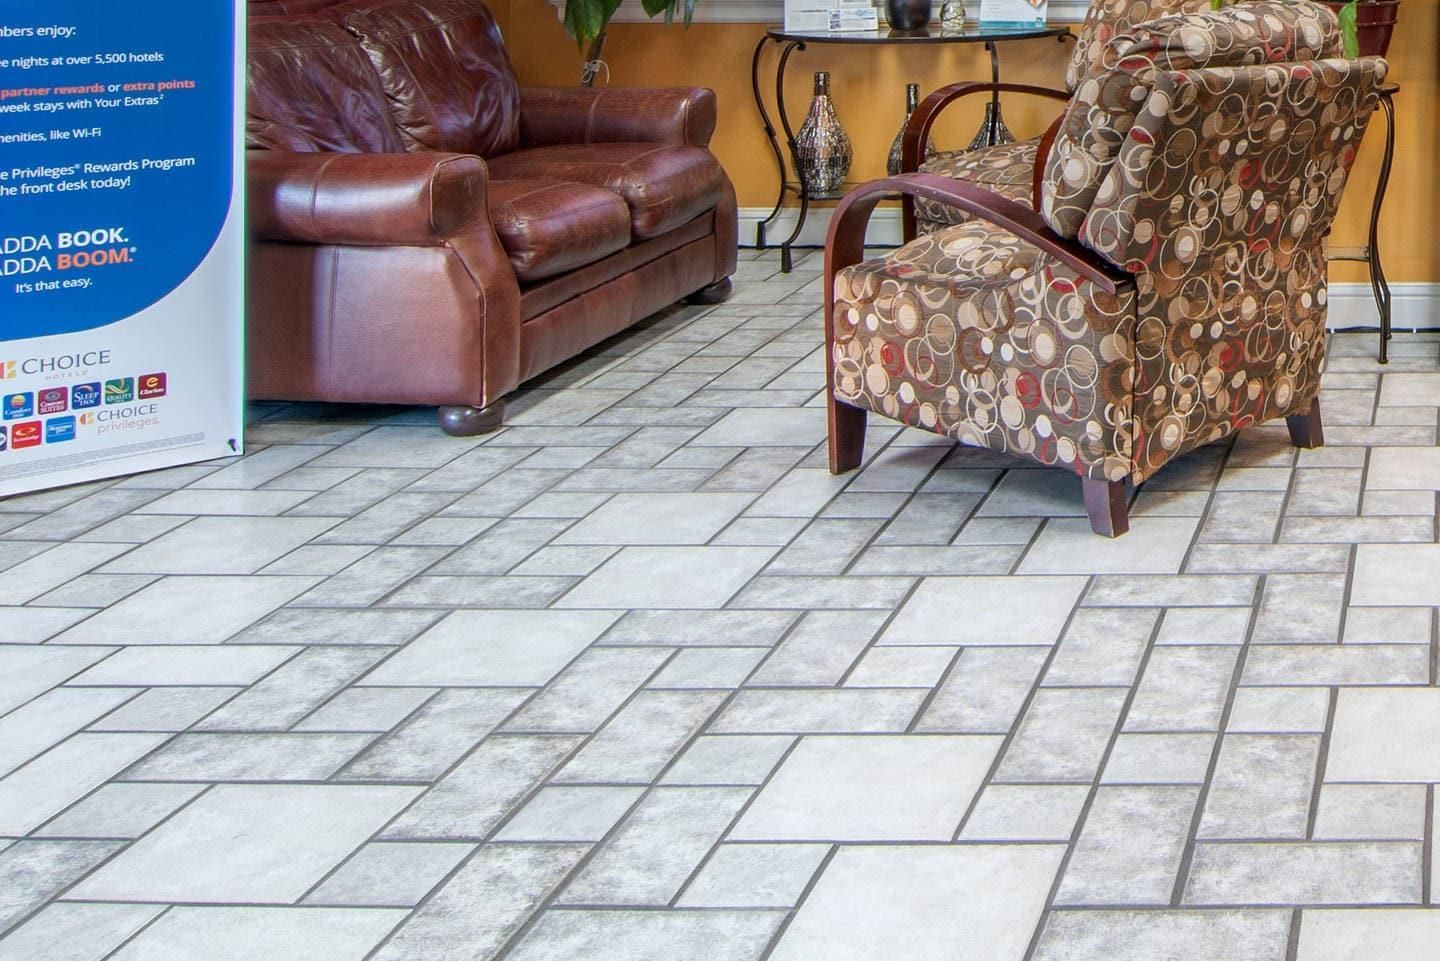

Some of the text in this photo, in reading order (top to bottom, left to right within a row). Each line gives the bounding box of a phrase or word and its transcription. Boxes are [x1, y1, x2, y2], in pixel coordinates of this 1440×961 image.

[36, 24, 77, 39] enjoy:
[12, 55, 49, 70] nights
[51, 57, 64, 66] at
[66, 56, 93, 65] over
[95, 53, 127, 65] 5,500
[128, 51, 164, 63] hotels
[1, 79, 196, 101] partner rewards or extra points
[0, 101, 31, 114] week
[33, 101, 65, 113] stays
[66, 99, 92, 110] with
[95, 96, 122, 109] Your
[50, 129, 71, 141] like
[72, 127, 102, 139] Wi-Fi
[83, 159, 139, 174] Rewards
[141, 156, 196, 171] Program
[21, 183, 54, 195] front
[57, 178, 88, 192] desk
[90, 175, 131, 191] today!
[0, 226, 129, 255] DDA BOOK.
[0, 255, 52, 277] DDA
[16, 276, 93, 294] It's that easy.
[22, 349, 112, 375] CHOICE
[73, 391, 99, 403] SLEEP
[79, 399, 95, 407] INN
[97, 404, 158, 422] CHOICE
